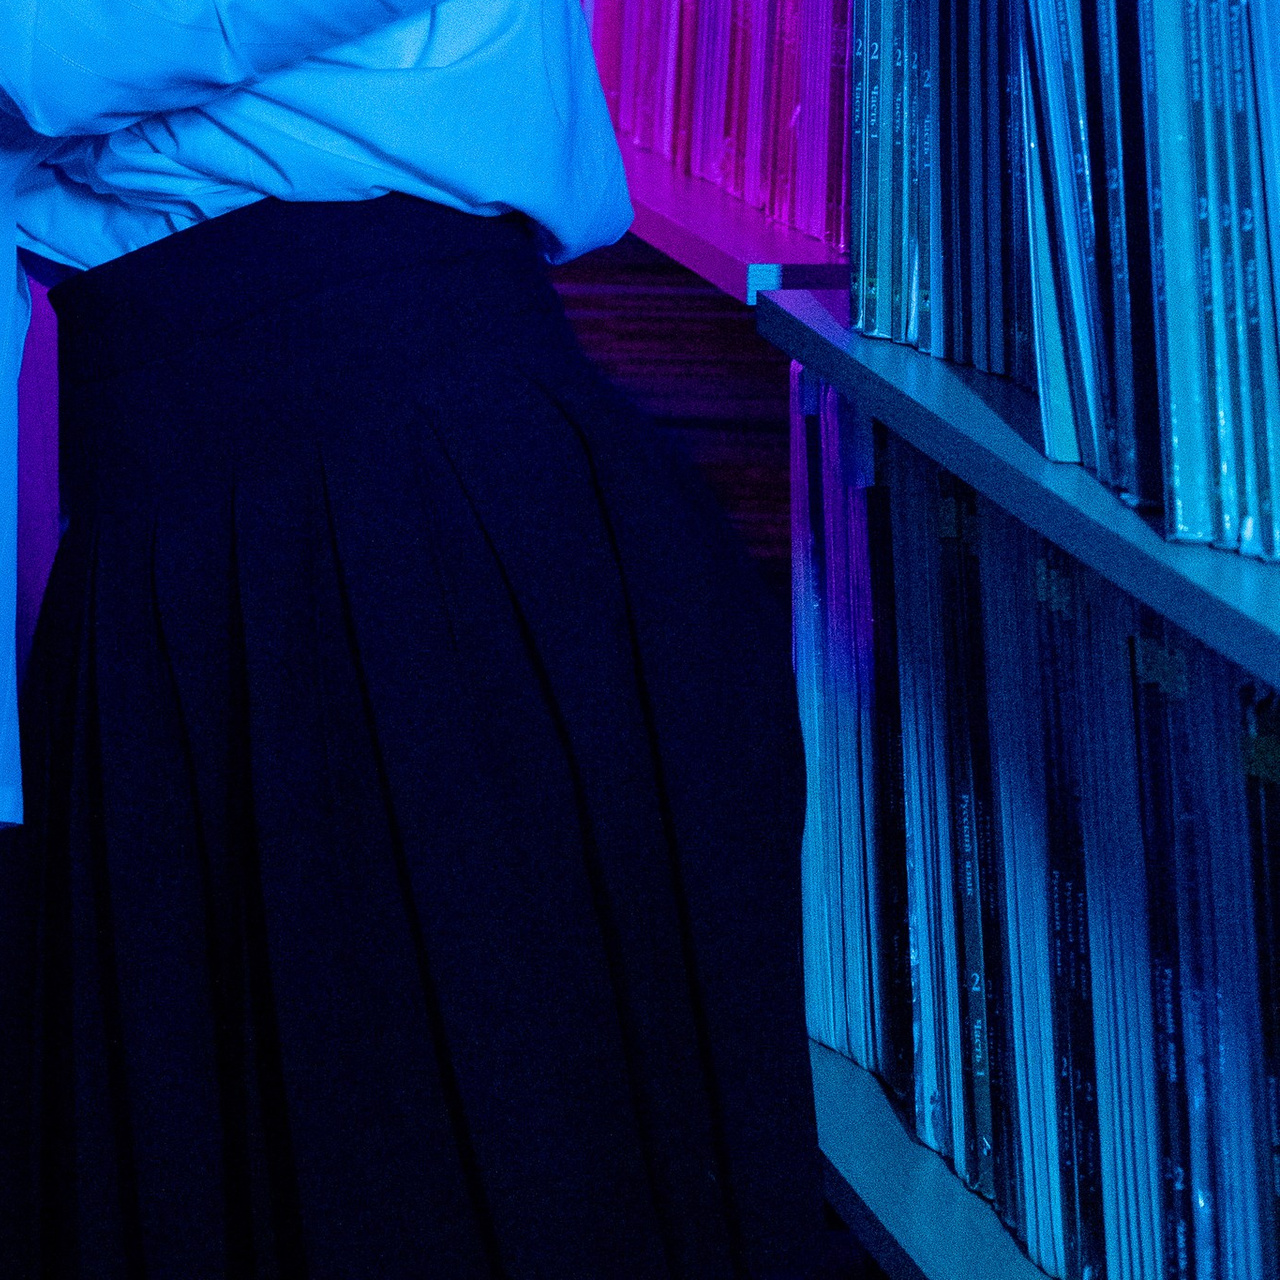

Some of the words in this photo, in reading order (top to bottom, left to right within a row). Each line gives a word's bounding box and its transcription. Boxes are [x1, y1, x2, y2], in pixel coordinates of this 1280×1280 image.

[854, 39, 863, 56] 2
[870, 42, 879, 60] 2
[922, 70, 932, 88] 2
[854, 81, 862, 122] Часть
[870, 85, 878, 126] Часть
[923, 114, 932, 154] Часть
[960, 794, 971, 852] Русский
[965, 861, 973, 896] язык
[971, 973, 981, 992] 2
[972, 1019, 982, 1062] Часть
